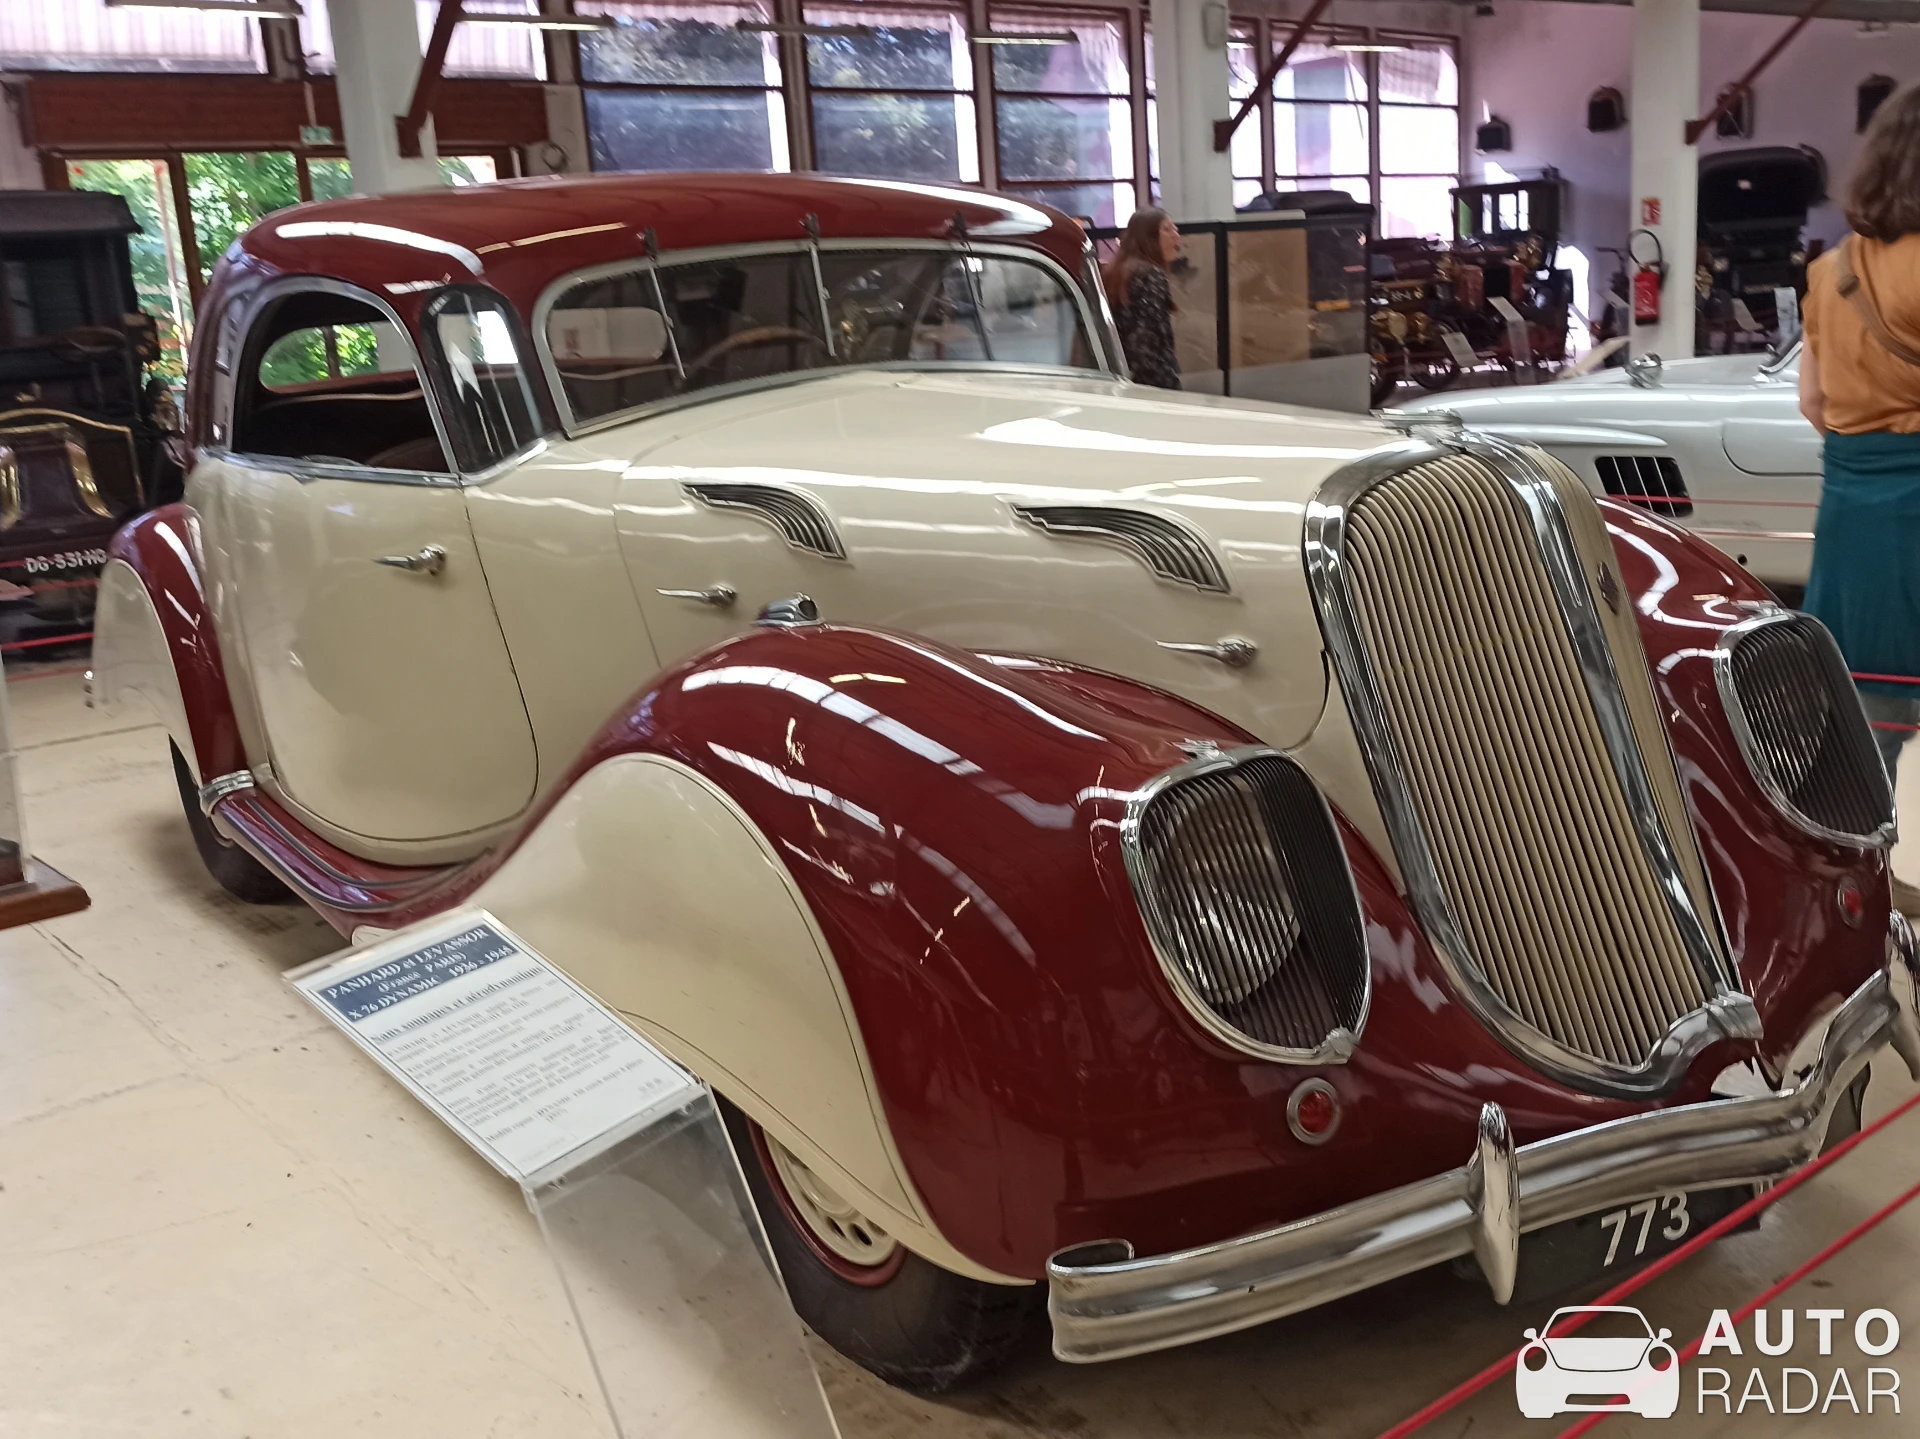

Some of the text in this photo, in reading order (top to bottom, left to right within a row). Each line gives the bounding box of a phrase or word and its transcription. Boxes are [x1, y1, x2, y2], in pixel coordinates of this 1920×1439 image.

[327, 927, 489, 999] PANHARD et LEVASSOR
[348, 1009, 363, 1021] X
[376, 975, 442, 1009] DYNAMIC
[1601, 1190, 1690, 1267] 773
